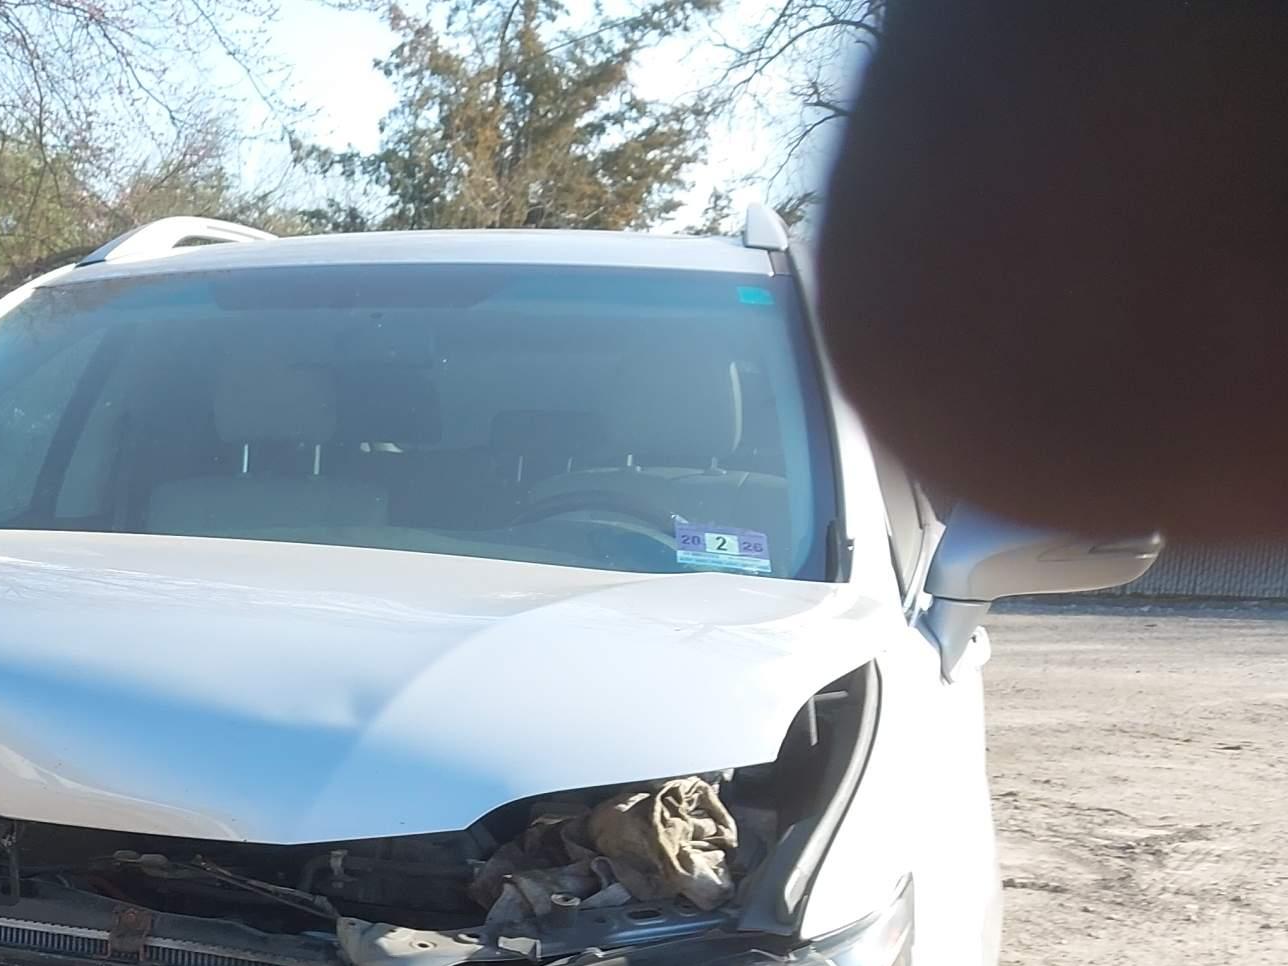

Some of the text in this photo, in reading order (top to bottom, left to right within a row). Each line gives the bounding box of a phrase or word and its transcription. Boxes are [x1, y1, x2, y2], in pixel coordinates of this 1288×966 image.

[682, 535, 763, 552] 20 2 26
